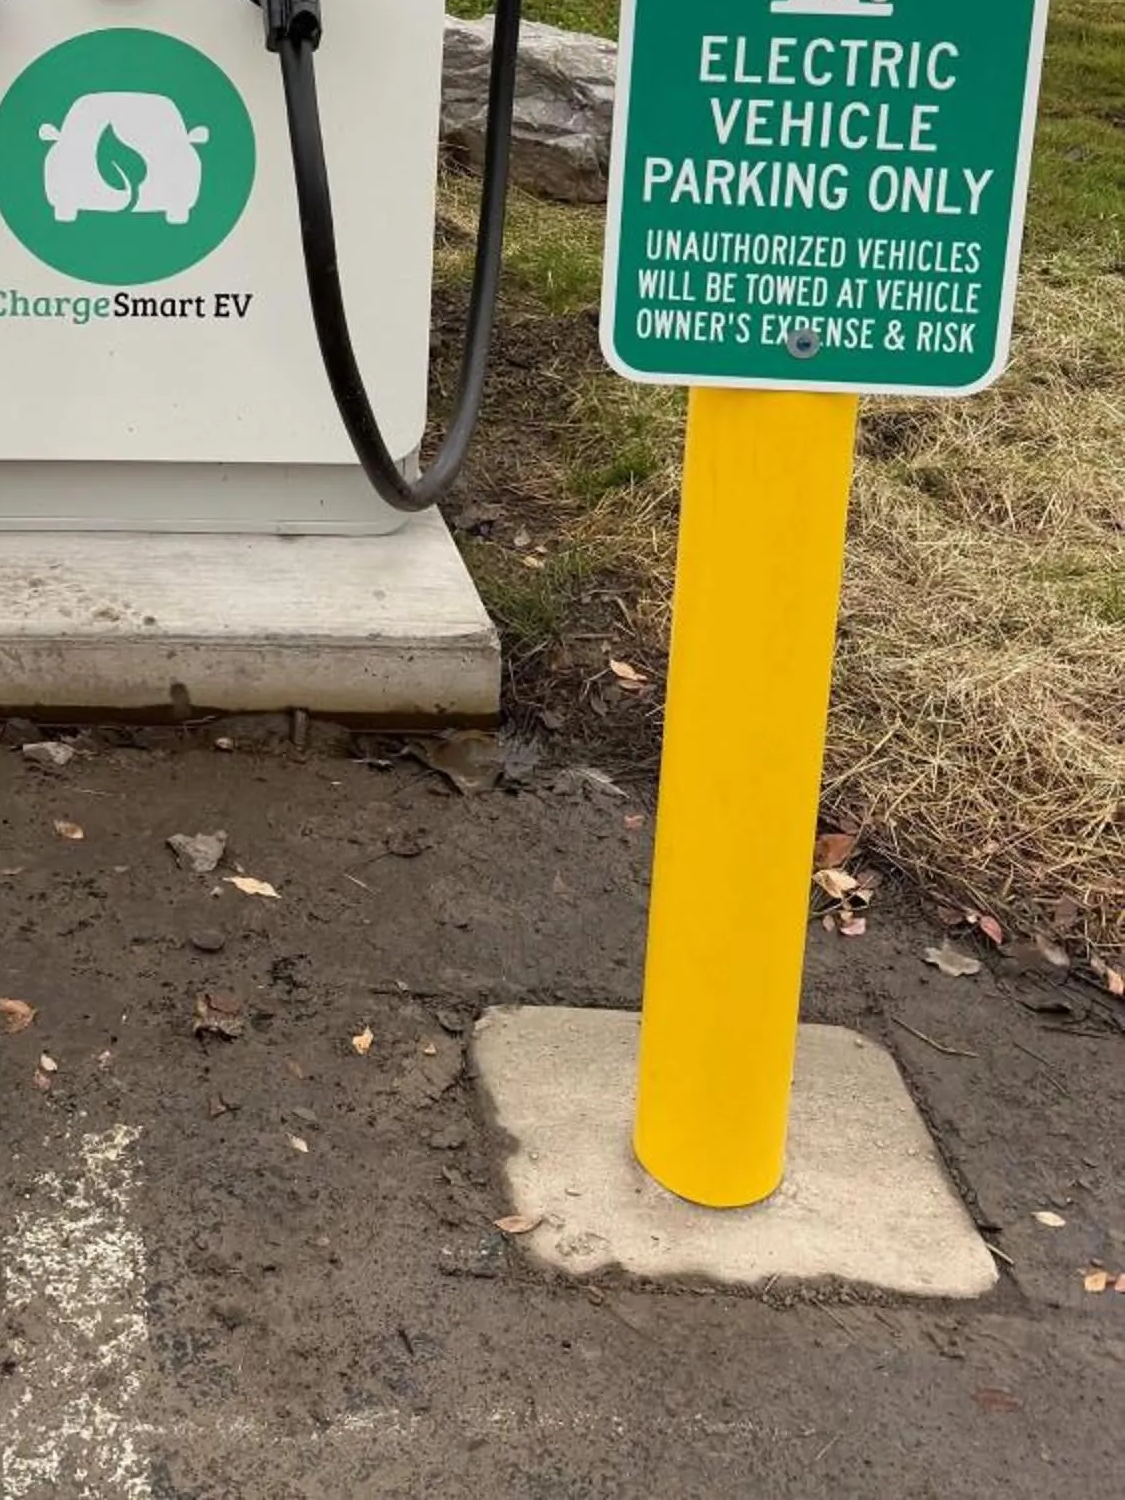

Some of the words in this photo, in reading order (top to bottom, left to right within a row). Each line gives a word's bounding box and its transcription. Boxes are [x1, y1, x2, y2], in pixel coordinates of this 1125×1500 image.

[700, 36, 958, 89] ELECTRIC
[710, 99, 939, 151] VEHICLE
[643, 158, 848, 209] PARKING
[868, 166, 994, 214] ONLY
[646, 230, 846, 267] UNAUTHORIZED
[858, 238, 981, 272] VEHICLES
[214, 293, 254, 318] EV
[639, 270, 695, 301] WILL
[706, 273, 736, 302] BE
[746, 274, 827, 306] TOWED
[836, 279, 868, 309] AT
[876, 280, 981, 313] VEHICLE
[636, 309, 751, 343] OWNER'S
[884, 320, 905, 350] &
[916, 322, 975, 353] RISK
